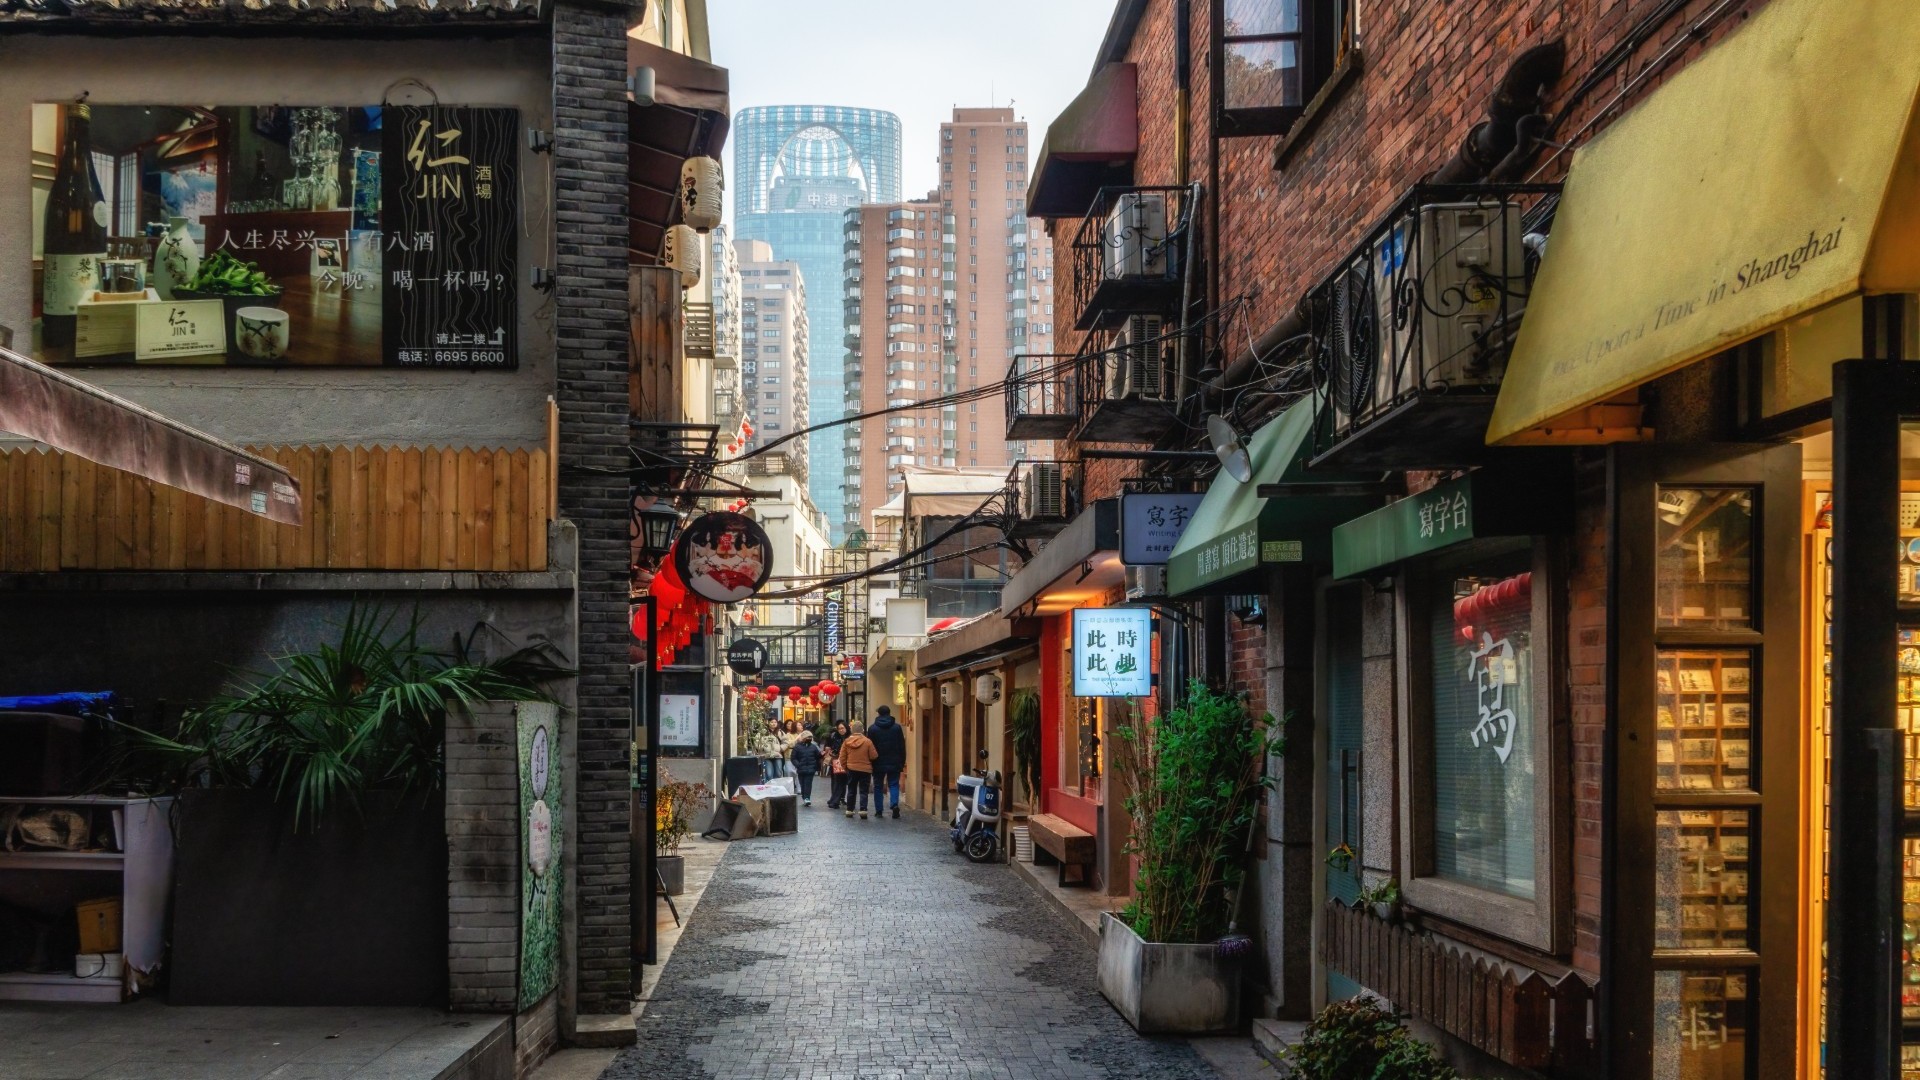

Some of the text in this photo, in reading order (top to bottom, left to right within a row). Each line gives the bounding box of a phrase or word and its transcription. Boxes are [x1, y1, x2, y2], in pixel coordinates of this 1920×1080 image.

[407, 120, 470, 171] 仁
[416, 174, 460, 198] JIN
[1654, 296, 1700, 331] Time
[1706, 279, 1726, 306] in
[1732, 217, 1846, 295] Shanghai
[172, 327, 187, 336] JIN
[436, 333, 486, 345] 请上二楼
[434, 351, 468, 362] 6695
[471, 351, 504, 362] 6600
[1147, 505, 1191, 527] 寫字
[1419, 491, 1467, 538] 寫字台
[827, 602, 839, 653] GUINNESS
